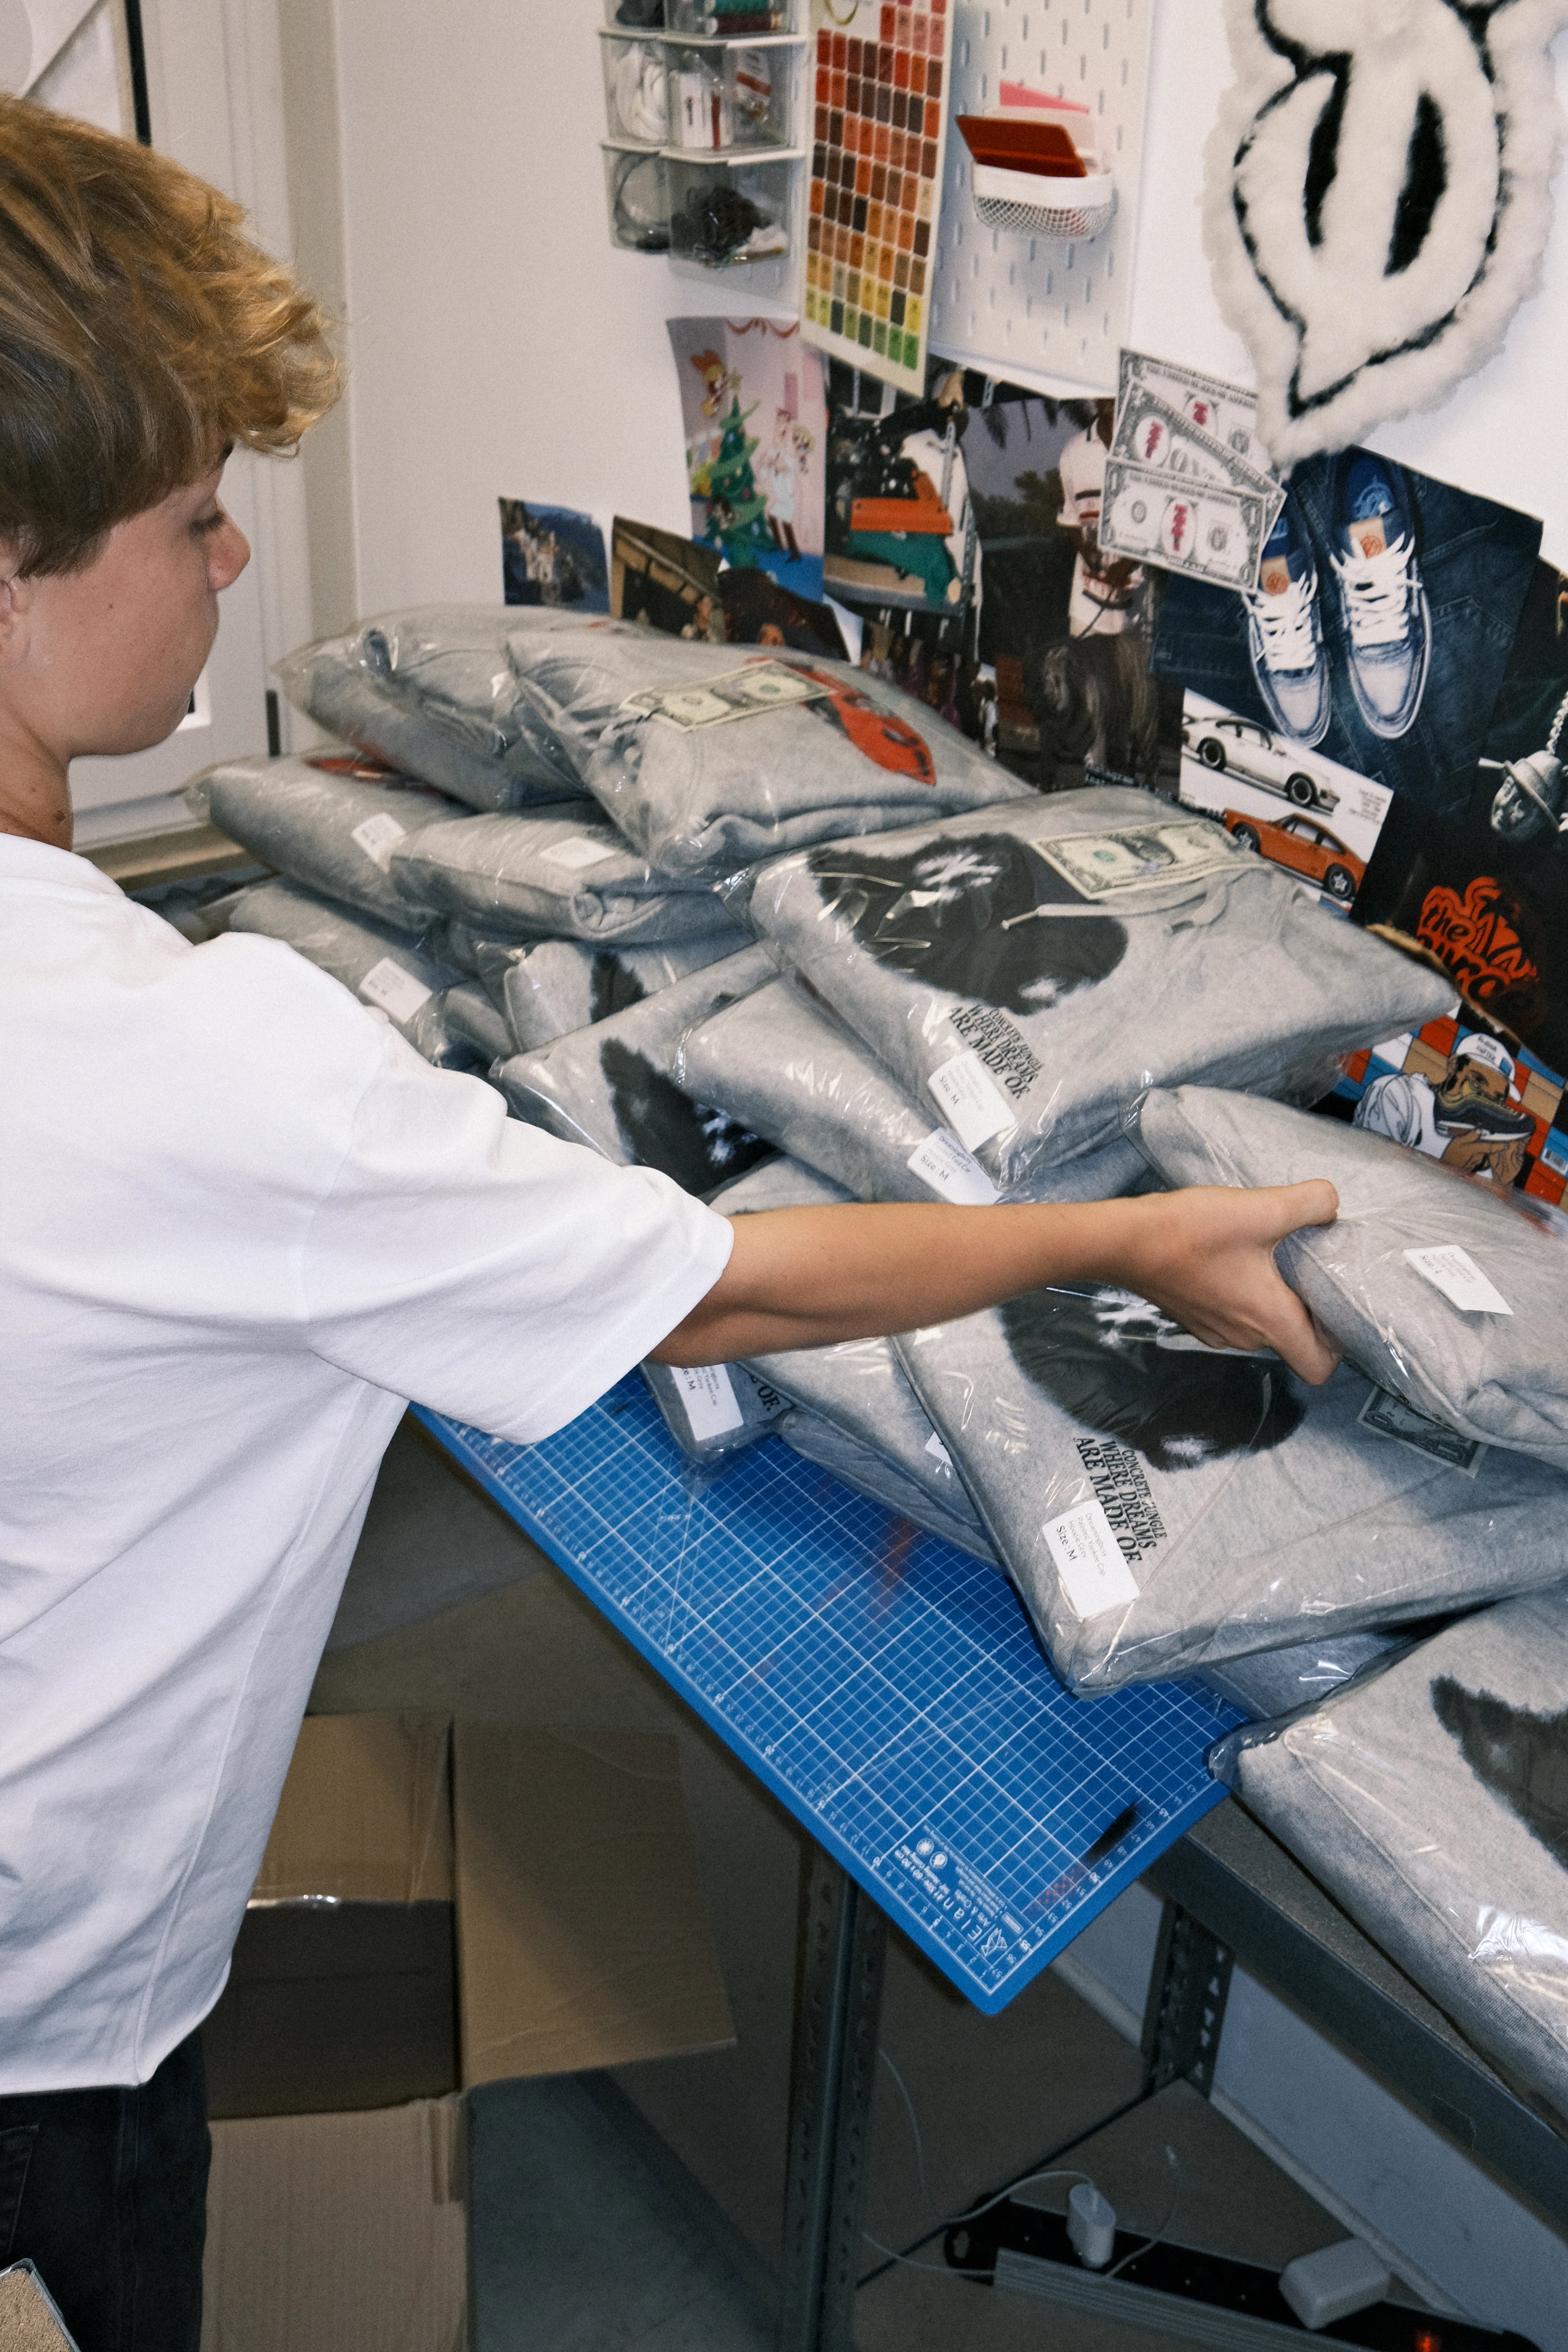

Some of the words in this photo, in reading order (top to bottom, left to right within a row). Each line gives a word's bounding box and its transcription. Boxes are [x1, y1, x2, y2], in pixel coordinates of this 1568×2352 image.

[949, 1007, 979, 1038] ARE
[969, 1030, 1013, 1074] MADE
[968, 1004, 1002, 1042] WHERE
[996, 1038, 1038, 1083] DREAMS
[938, 1075, 953, 1092] Size
[949, 1093, 961, 1105] M
[920, 1154, 938, 1171] Size
[938, 1169, 950, 1181] M
[686, 1380, 696, 1390] M
[1074, 1438, 1106, 1470] ARE
[1100, 1440, 1134, 1488] WHERE
[1118, 1491, 1157, 1549] DREAMS
[1122, 1450, 1152, 1498] CONCRETE
[1141, 1501, 1167, 1539] JUNGLE
[1089, 1474, 1129, 1530] MADE
[1056, 1525, 1071, 1546] Size
[1066, 1549, 1078, 1561] M
[1076, 1516, 1091, 1540] Painted
[1086, 1539, 1101, 1563] Yankee
[1096, 1562, 1107, 1577] Cap
[1077, 1542, 1089, 1559] Grey
[763, 1744, 776, 1756] 20
[1186, 1783, 1197, 1794] 43
[1172, 1795, 1184, 1806] 44
[1158, 1806, 1170, 1818] 45
[1144, 1819, 1156, 1830] 46
[1131, 1832, 1143, 1843] 47
[871, 1855, 883, 1867] 10
[1103, 1858, 1114, 1869] 49
[885, 1869, 893, 1878] 9
[1089, 1870, 1101, 1883] 50
[896, 1881, 905, 1890] 8
[1076, 1884, 1087, 1896] 51
[951, 1887, 974, 1910] Crafts
[1061, 1898, 1073, 1909] 52
[920, 1905, 929, 1914] 6
[969, 1905, 980, 1916] &
[931, 1917, 941, 1927] 5
[975, 1911, 992, 1928] Arts
[1047, 1911, 1059, 1923] 53
[1033, 1925, 1045, 1937] 54
[956, 1942, 964, 1951] 3
[1019, 1938, 1031, 1951] 55
[969, 1955, 977, 1963] 2
[1005, 1952, 1018, 1964] 56
[991, 1966, 1003, 1978] 57
